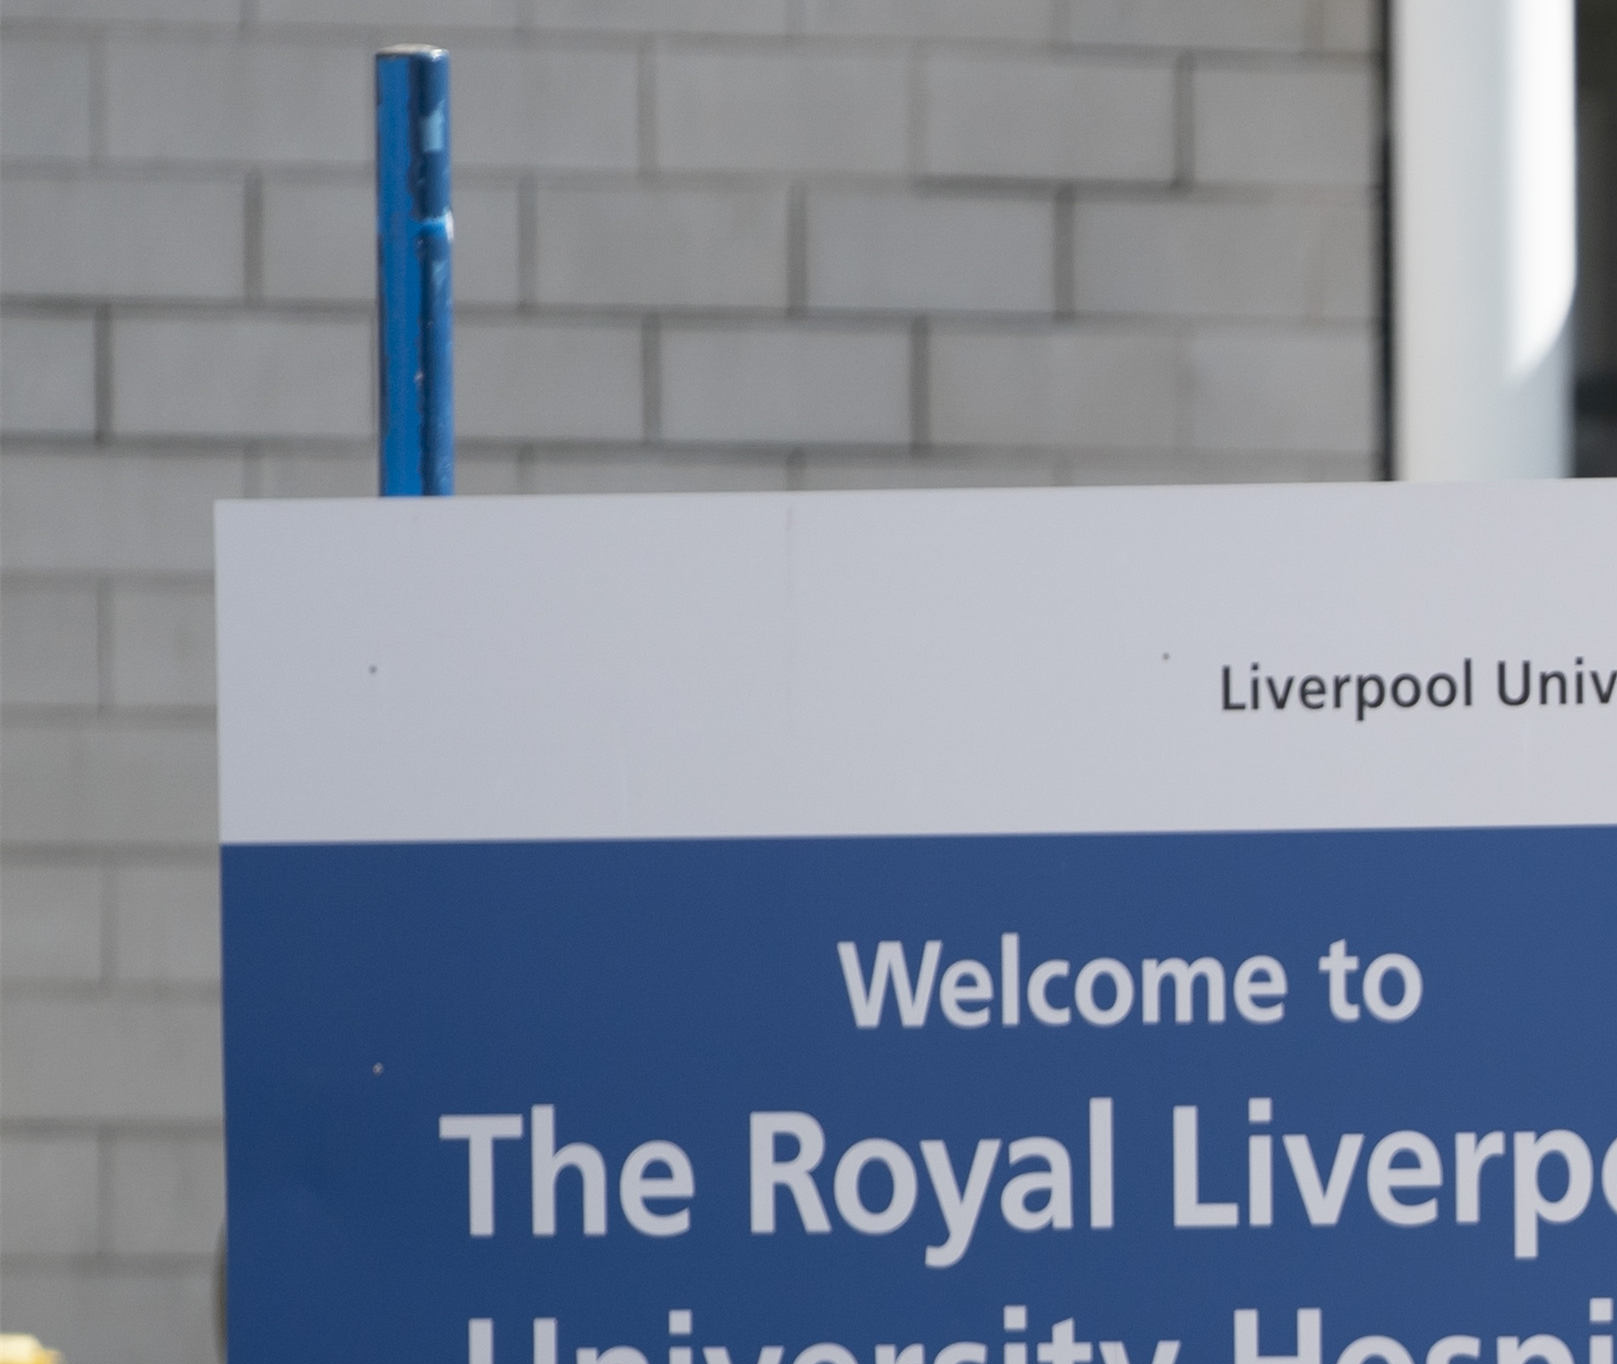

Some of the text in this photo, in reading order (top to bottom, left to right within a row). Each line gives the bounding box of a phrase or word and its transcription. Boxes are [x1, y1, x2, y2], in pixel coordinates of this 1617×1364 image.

[1221, 658, 1474, 722] Liverpool
[836, 932, 1423, 1028] Welcome to
[439, 1104, 695, 1237] The
[749, 1096, 1114, 1268] Royal
